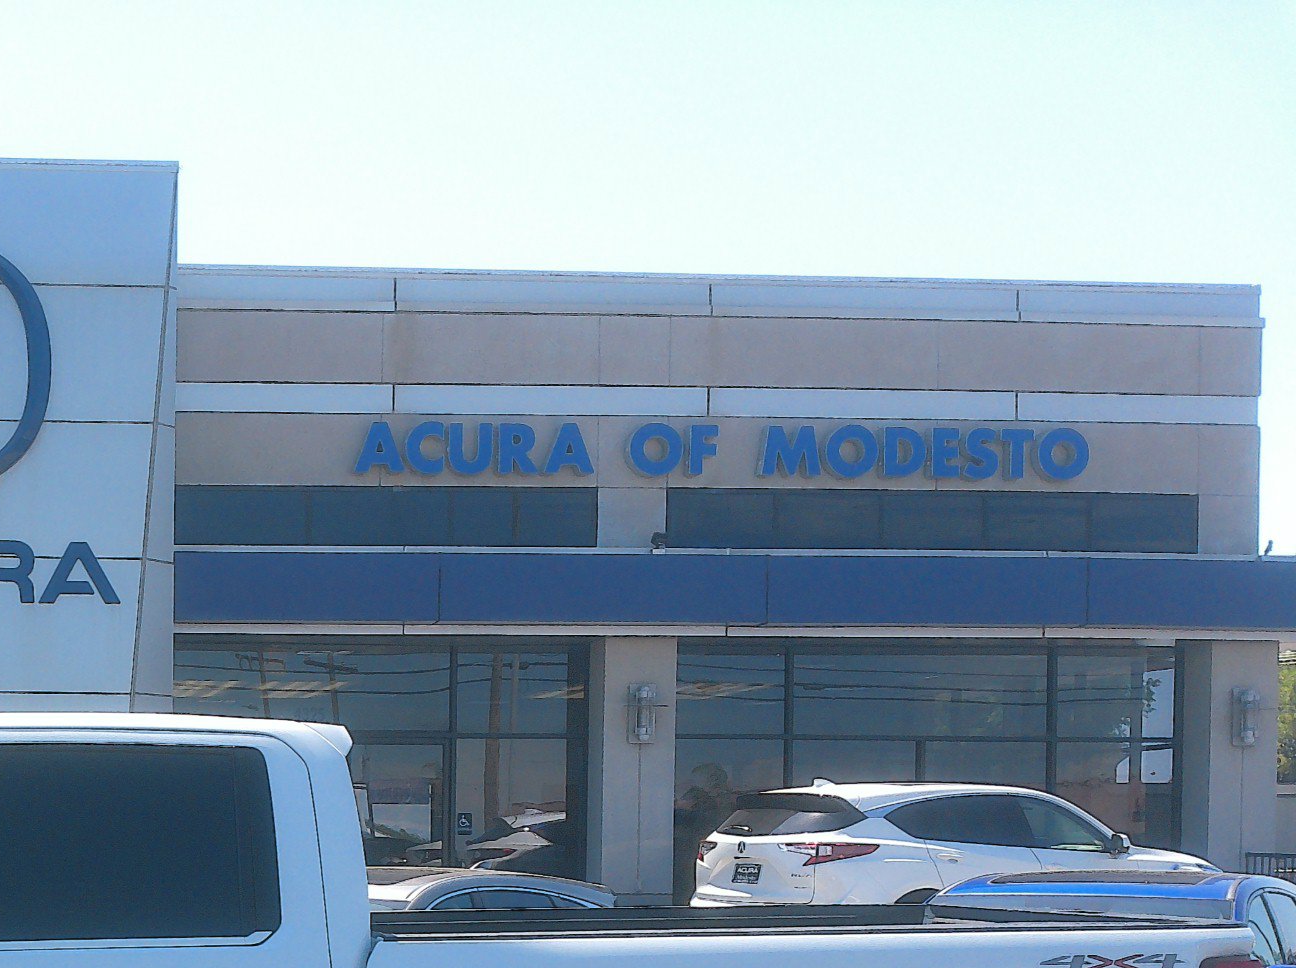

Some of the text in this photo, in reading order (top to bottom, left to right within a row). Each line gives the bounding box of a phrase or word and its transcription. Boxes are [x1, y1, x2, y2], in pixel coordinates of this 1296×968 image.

[353, 420, 1091, 480] ACURA OF MODESTO
